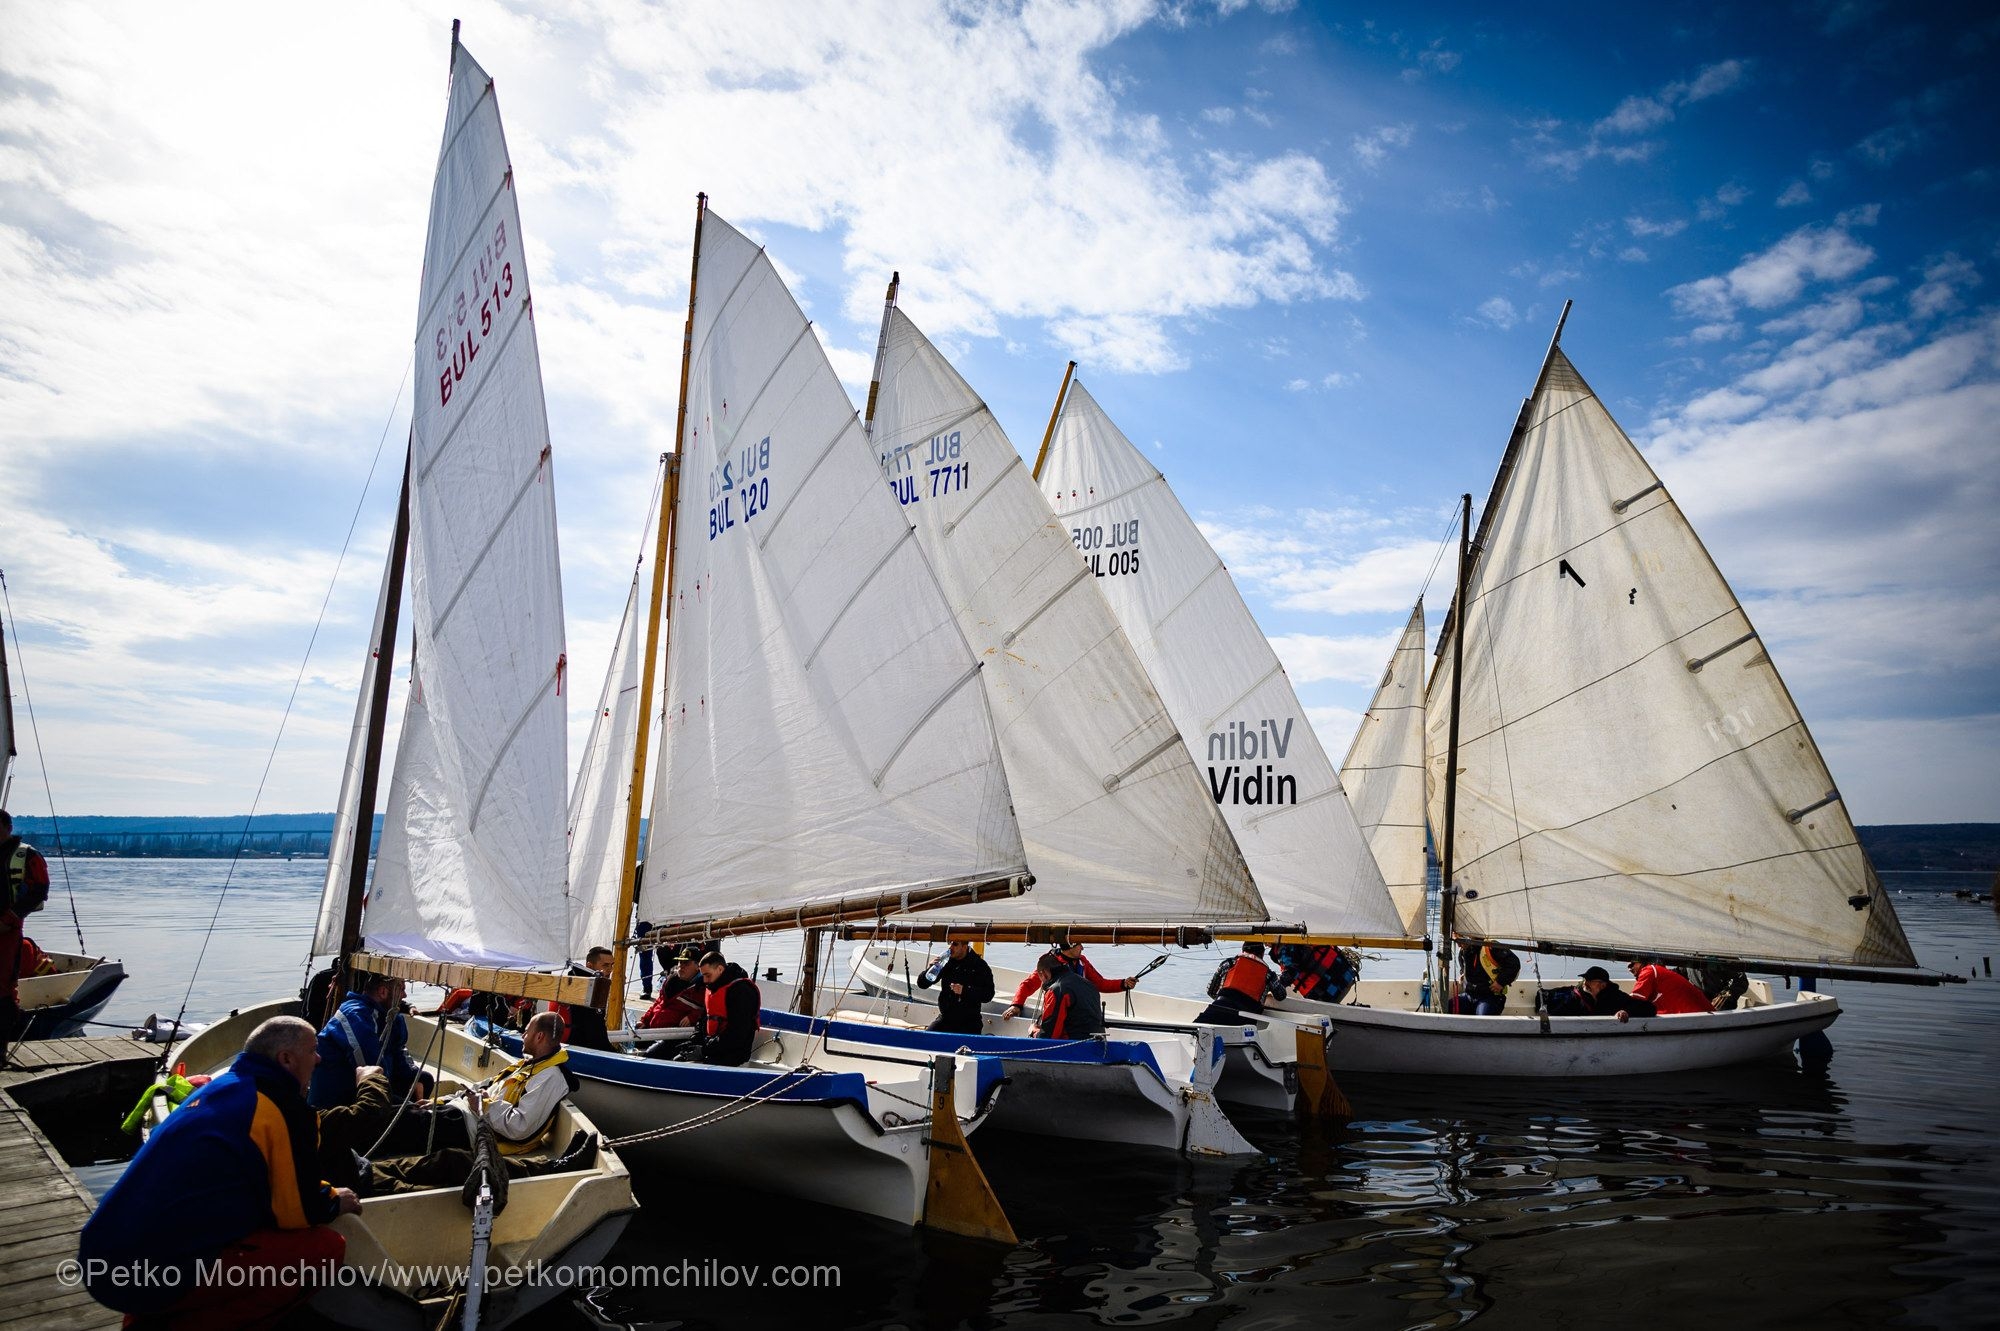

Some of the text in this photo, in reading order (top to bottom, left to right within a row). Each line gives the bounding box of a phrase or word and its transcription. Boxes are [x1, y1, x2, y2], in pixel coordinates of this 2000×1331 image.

[440, 262, 513, 408] BUL 513
[929, 461, 969, 498] 7711
[709, 497, 735, 541] BUL
[1108, 548, 1140, 577] 005
[1207, 764, 1297, 806] Vidin
